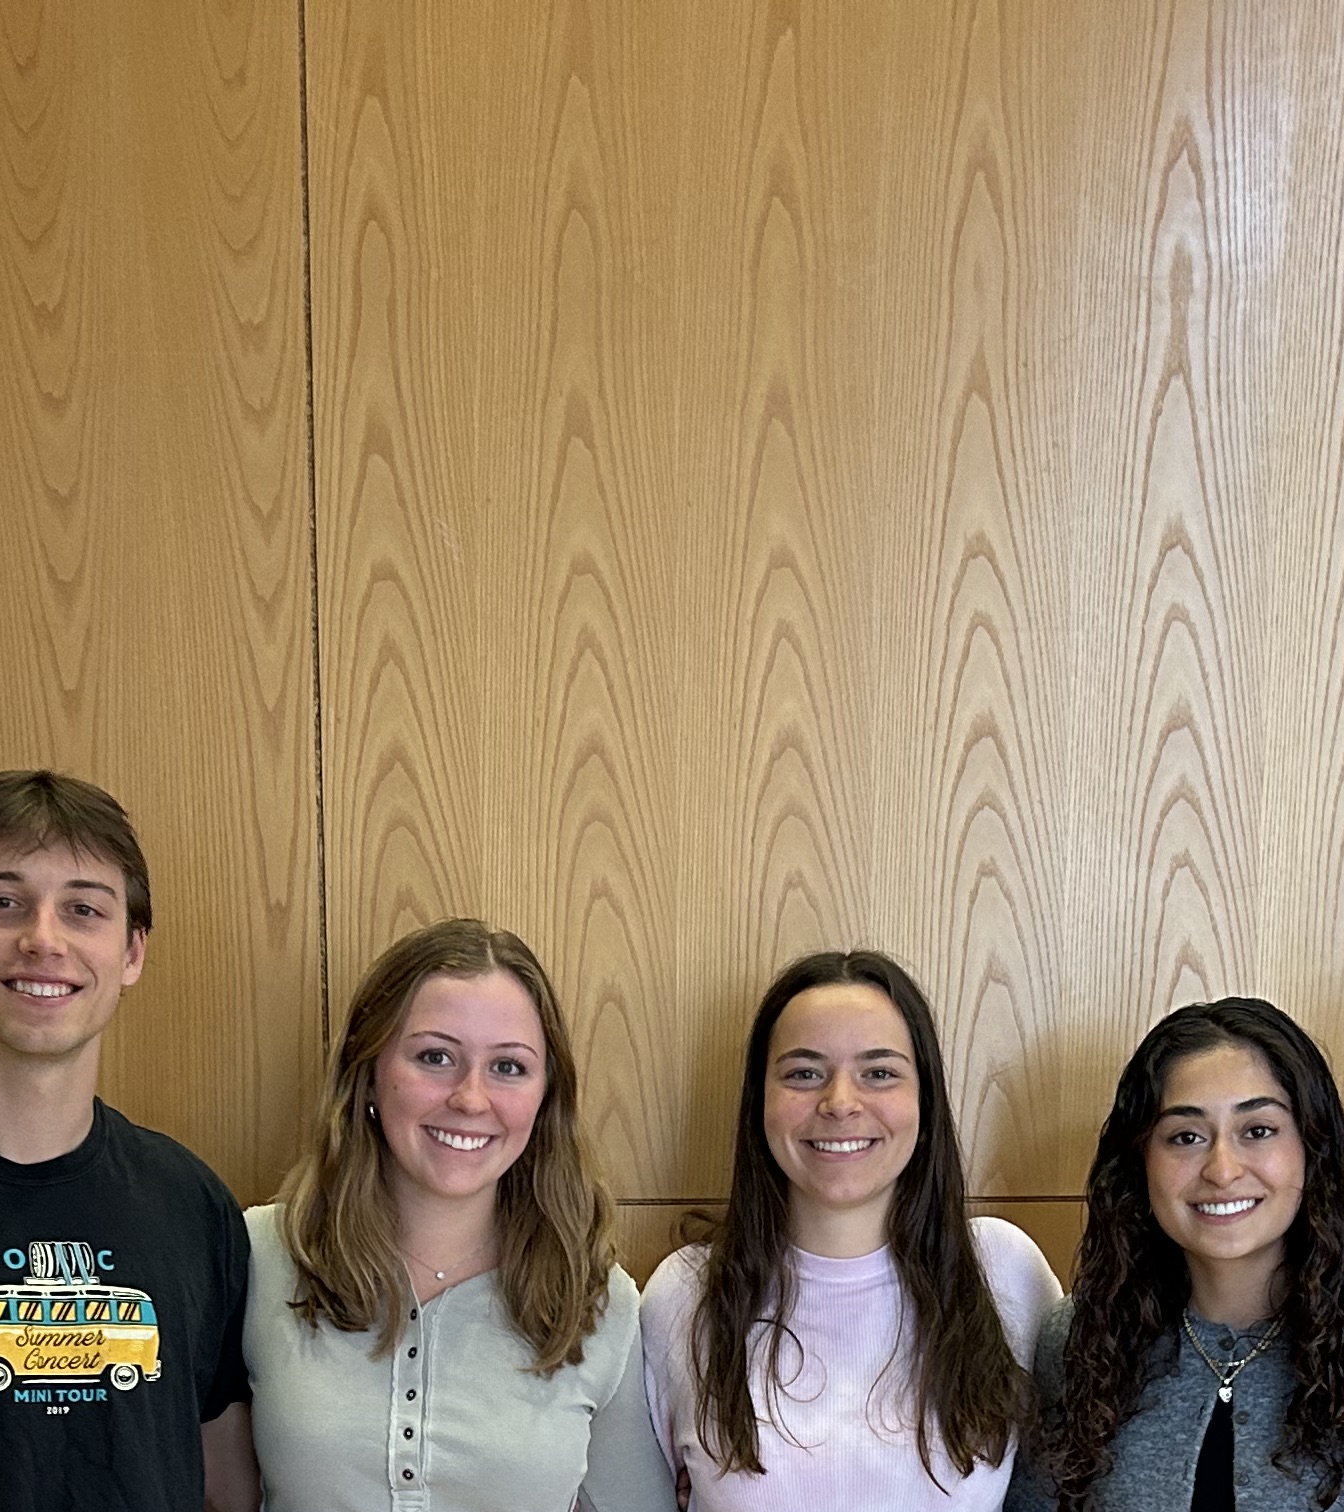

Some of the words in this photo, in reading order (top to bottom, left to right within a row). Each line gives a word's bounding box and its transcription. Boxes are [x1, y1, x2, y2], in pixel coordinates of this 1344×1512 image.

[3, 1248, 26, 1270] O
[97, 1250, 115, 1271] C
[15, 1325, 106, 1347] Summer
[23, 1348, 100, 1370] Concert
[13, 1388, 52, 1403] MINI
[56, 1388, 108, 1403] TOUR
[46, 1406, 71, 1415] 2019
